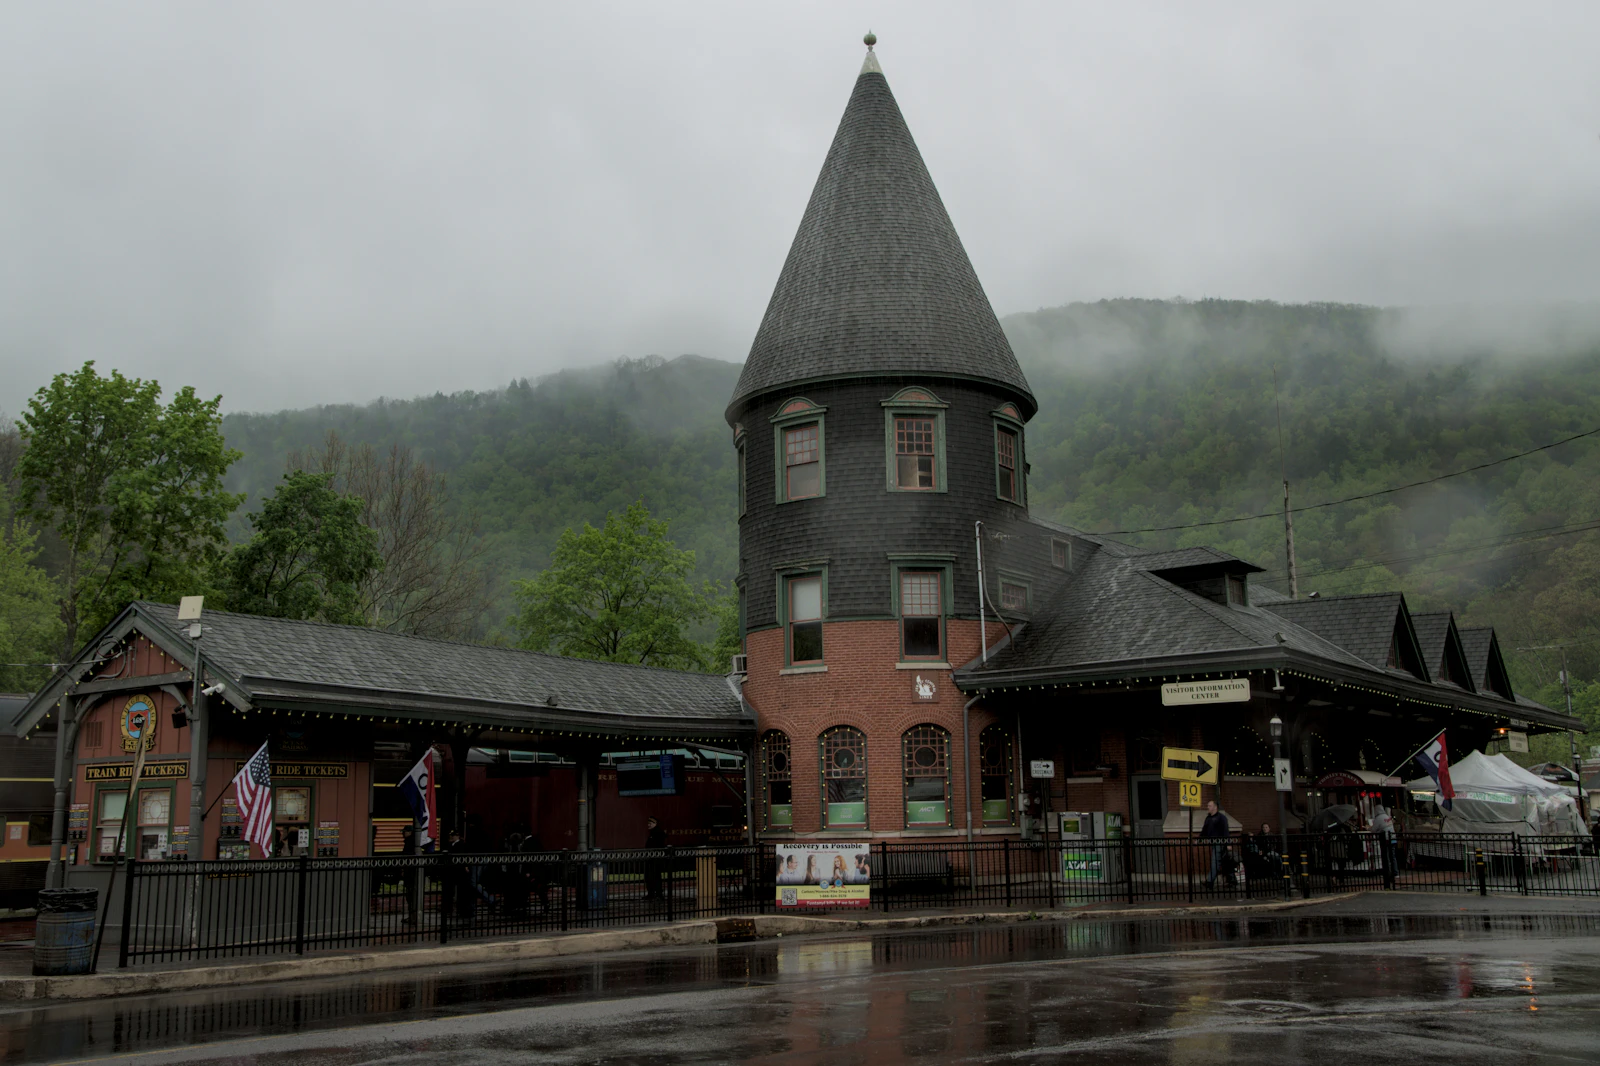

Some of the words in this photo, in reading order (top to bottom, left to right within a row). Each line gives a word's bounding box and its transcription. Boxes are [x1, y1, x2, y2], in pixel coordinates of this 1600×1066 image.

[1196, 683, 1245, 692] INFORMATION
[1191, 692, 1219, 700] CENTER
[87, 767, 117, 778] TRAIN
[144, 764, 185, 776] TICKETS
[276, 765, 301, 775] RIDE
[303, 765, 346, 776] TICKETS
[1182, 784, 1198, 796] 10
[1107, 815, 1121, 827] ATM
[1066, 861, 1087, 870] ATM
